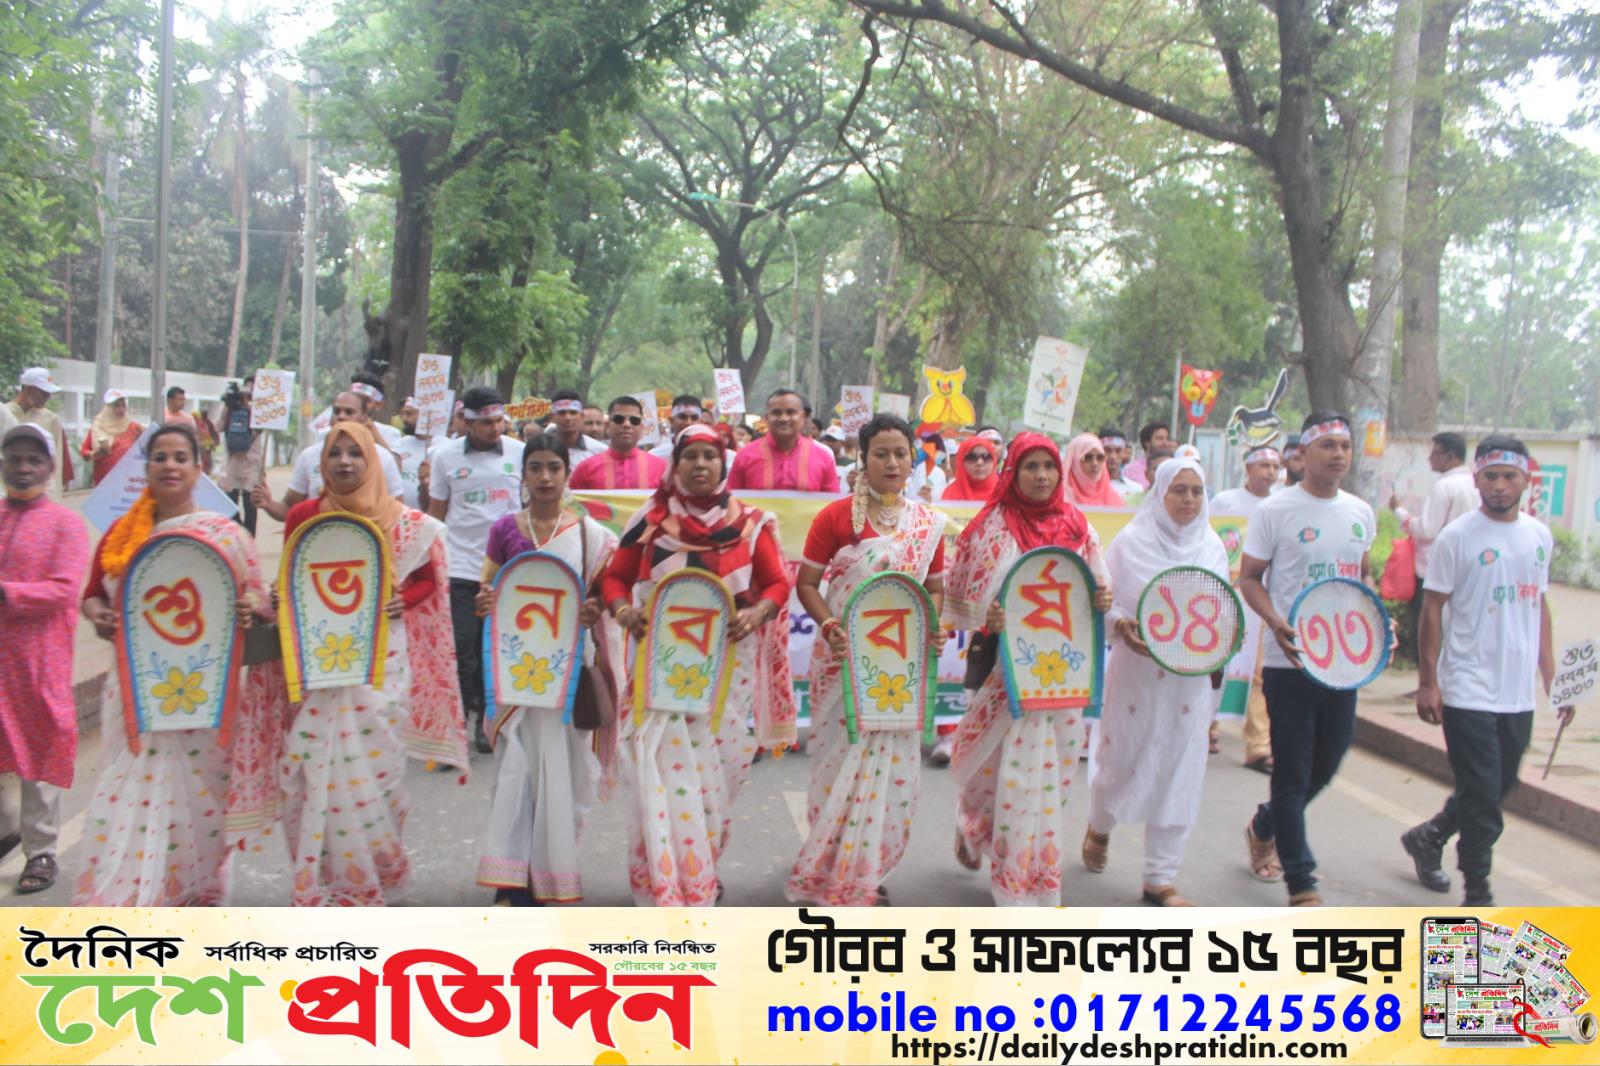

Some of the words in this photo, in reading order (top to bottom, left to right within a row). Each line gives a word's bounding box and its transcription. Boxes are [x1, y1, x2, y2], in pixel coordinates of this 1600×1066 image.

[143, 577, 206, 647] শু
[308, 558, 366, 616] ভ
[514, 584, 567, 640] ন
[667, 605, 721, 657] ব
[862, 607, 912, 661] ব
[1148, 584, 1222, 654] ১৪
[1298, 609, 1374, 670] ৩৩
